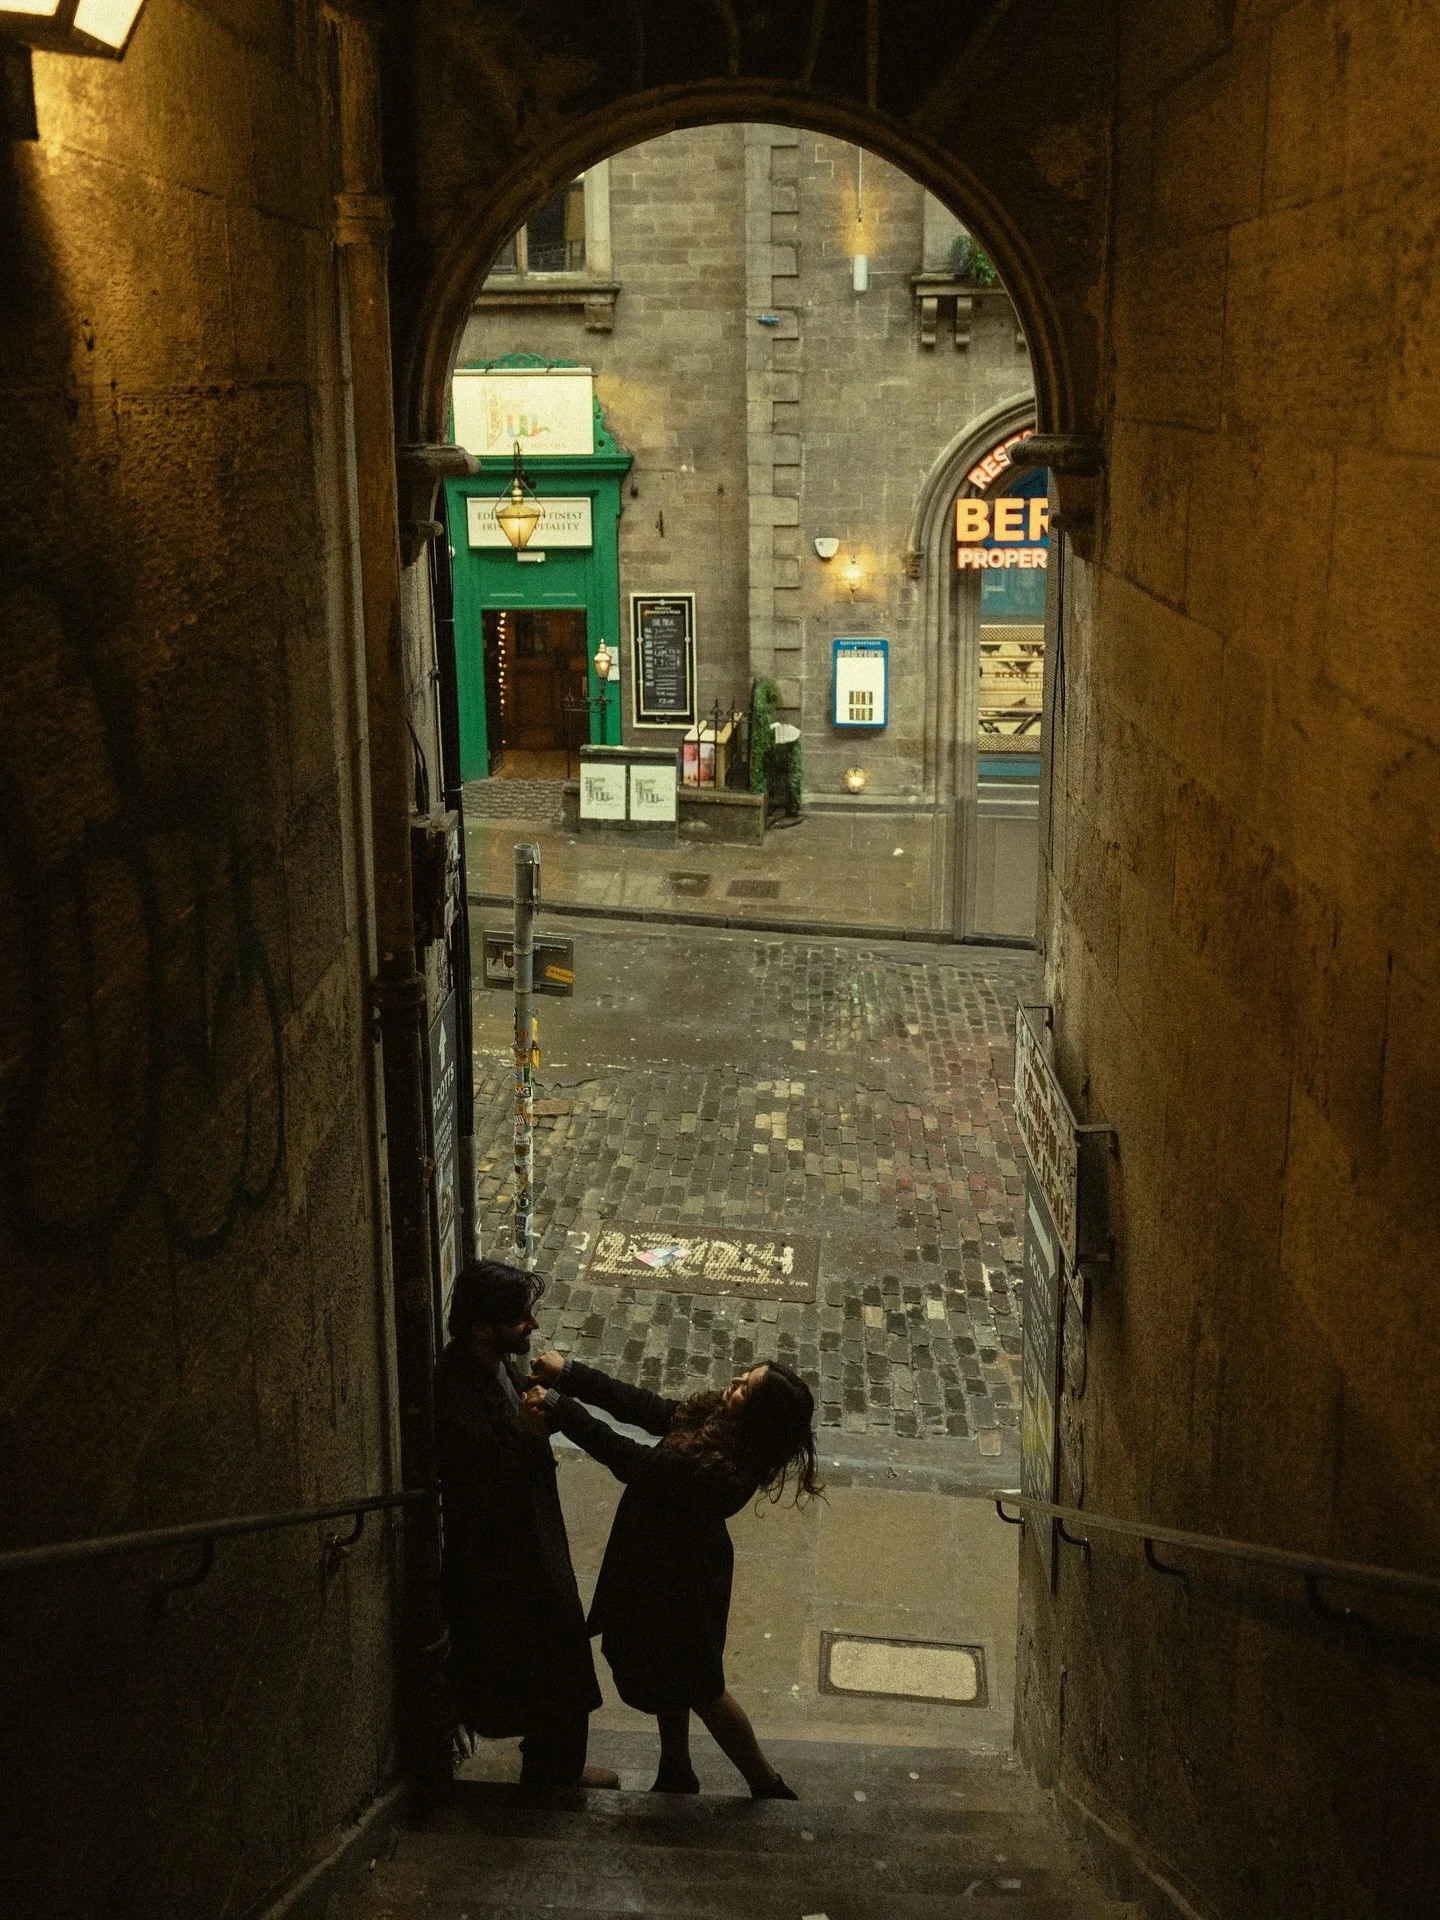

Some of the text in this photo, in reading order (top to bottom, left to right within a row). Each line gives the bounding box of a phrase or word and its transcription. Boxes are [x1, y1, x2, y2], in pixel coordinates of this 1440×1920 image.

[483, 523, 502, 531] IRIS
[957, 548, 1048, 569] PROPER
[433, 1061, 454, 1117] SCOTTS
[1029, 1244, 1051, 1317] SCOTTS
